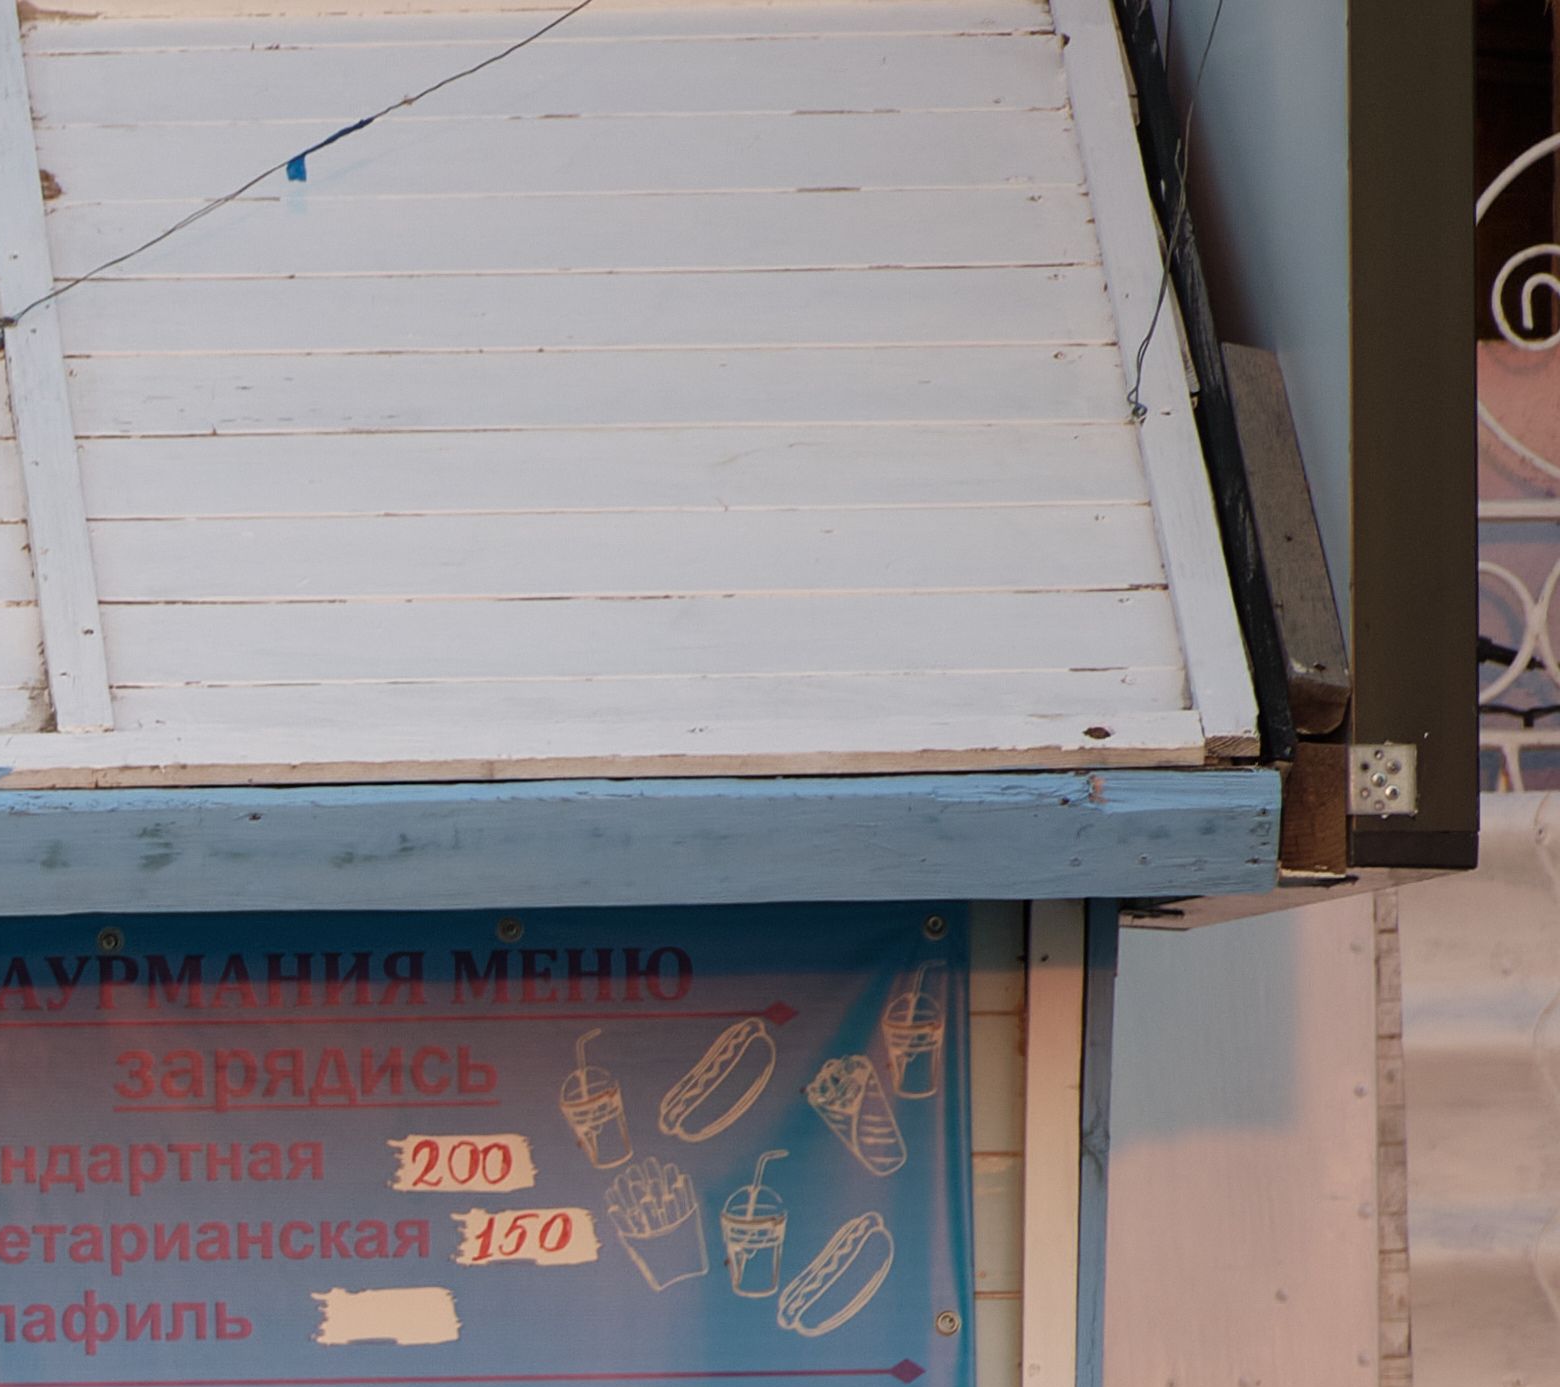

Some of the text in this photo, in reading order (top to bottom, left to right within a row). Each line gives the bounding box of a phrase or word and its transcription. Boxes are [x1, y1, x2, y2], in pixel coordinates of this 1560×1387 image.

[450, 945, 694, 1005] МЕНЮ
[114, 1043, 498, 1112] зарядись
[409, 1137, 515, 1189] 200
[471, 1211, 575, 1262] 150
